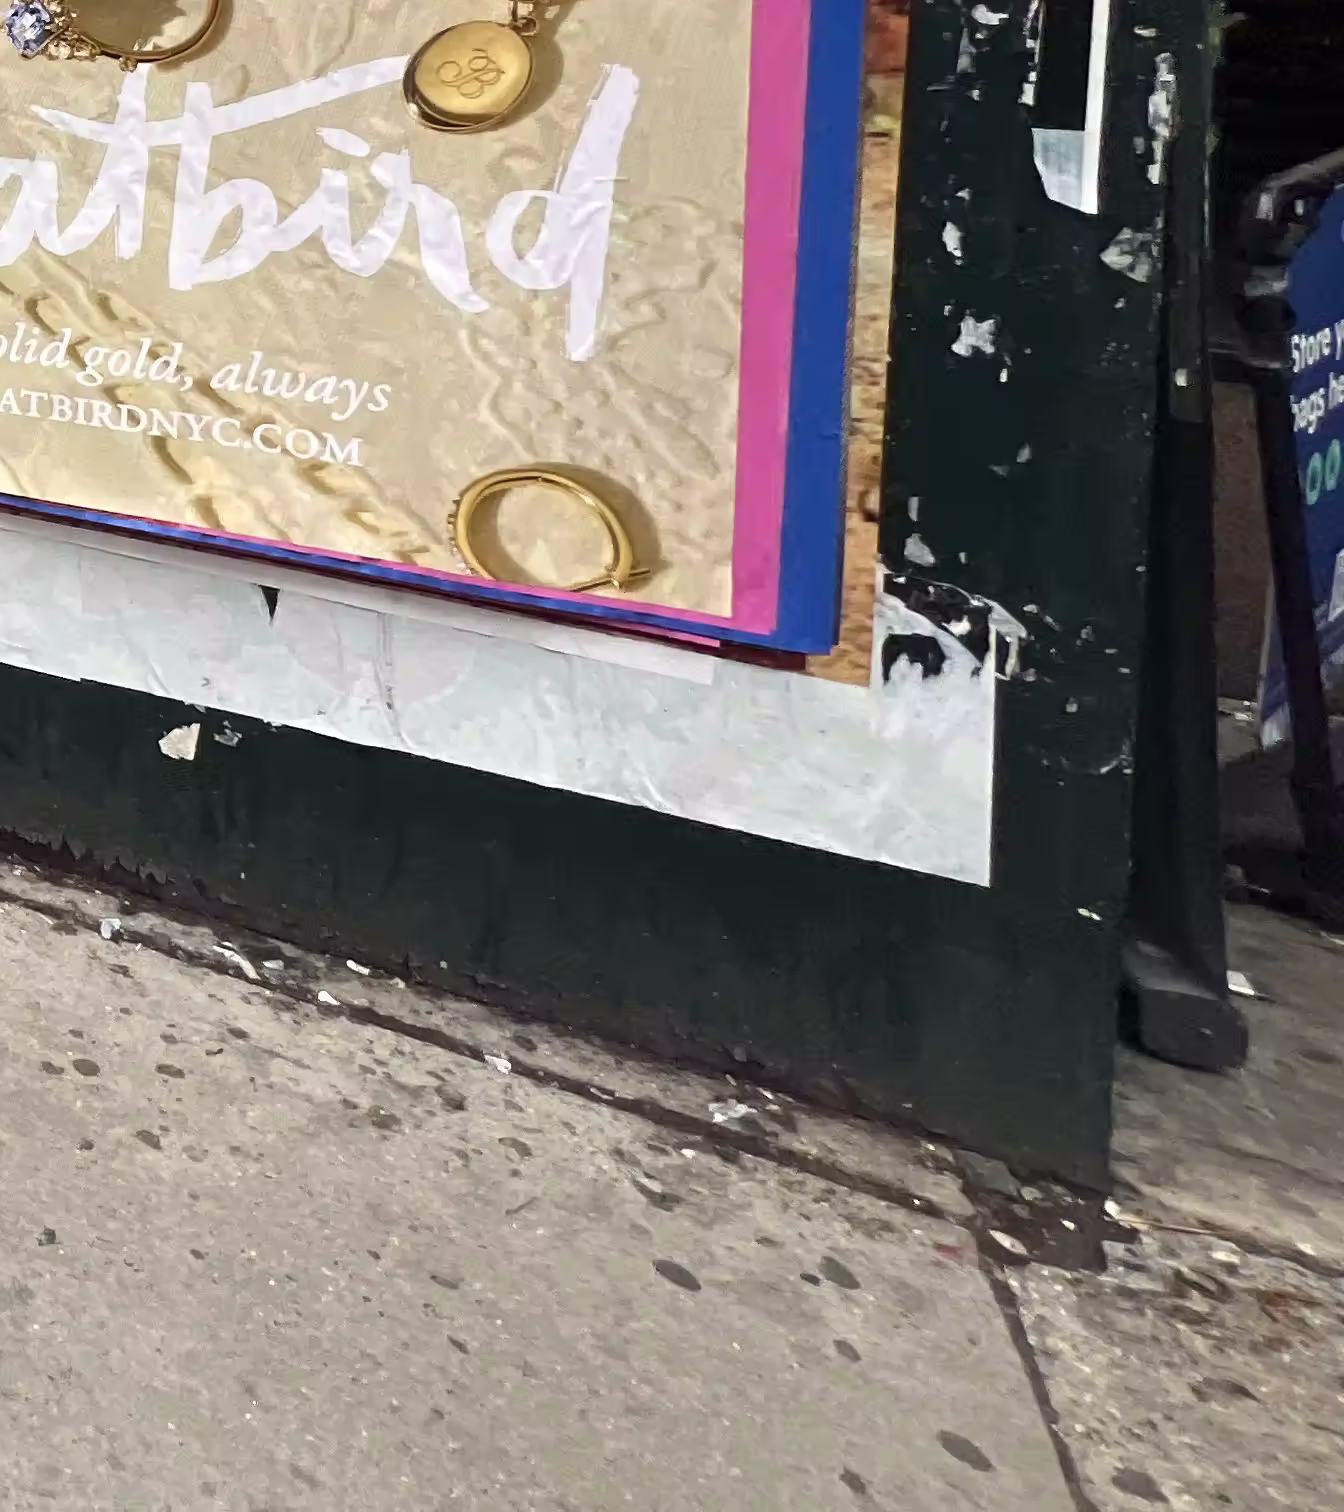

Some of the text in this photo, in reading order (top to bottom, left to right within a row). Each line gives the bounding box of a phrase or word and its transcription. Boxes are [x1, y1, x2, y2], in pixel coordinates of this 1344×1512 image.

[75, 337, 194, 392] gold,
[209, 350, 392, 422] always
[1291, 327, 1331, 373] Store
